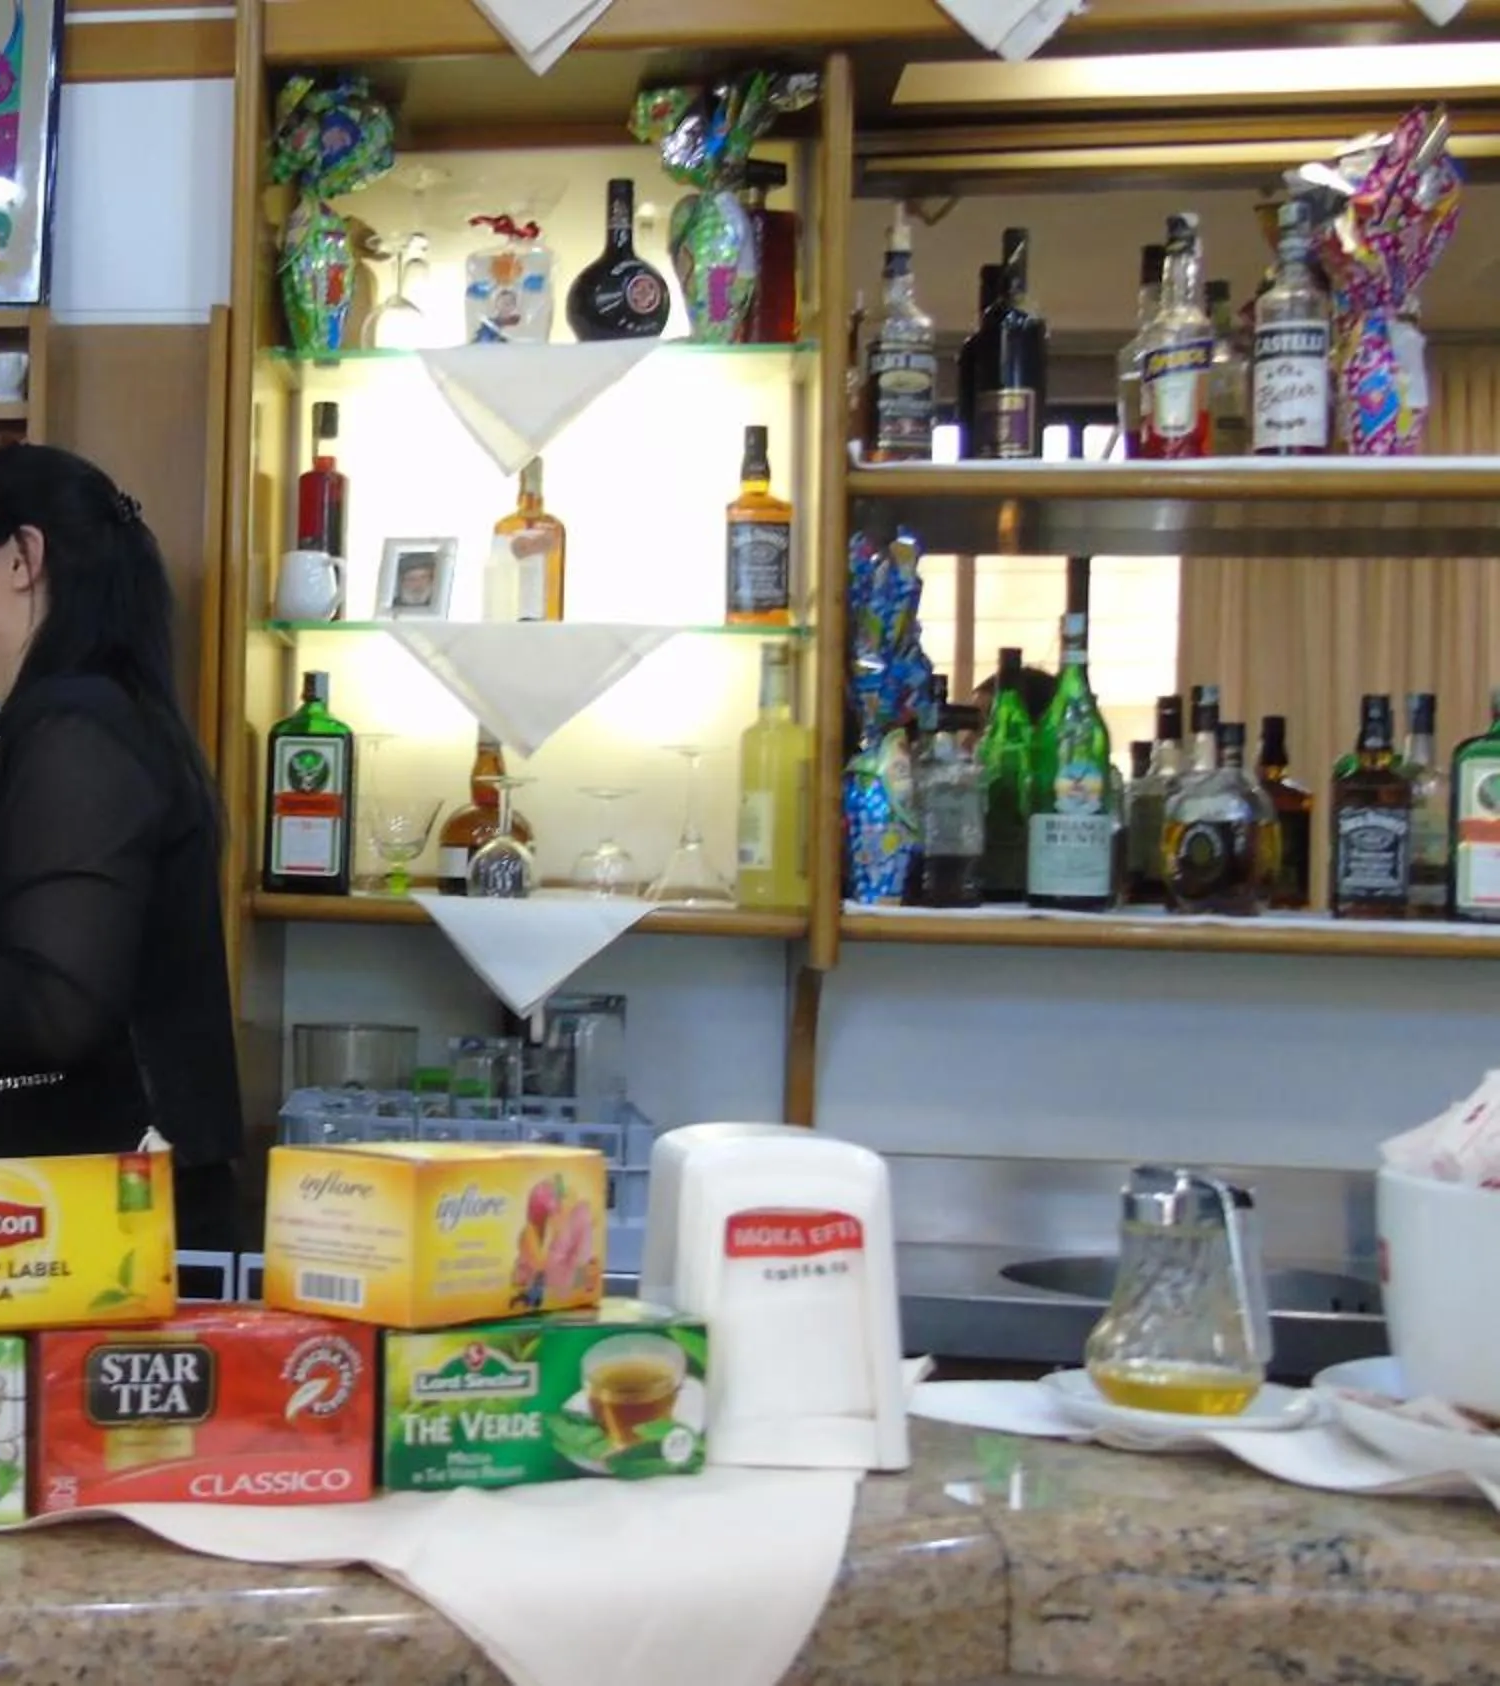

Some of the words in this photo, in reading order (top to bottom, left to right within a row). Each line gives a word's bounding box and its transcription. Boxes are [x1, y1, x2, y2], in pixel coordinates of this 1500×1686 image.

[298, 1169, 376, 1200] infiore
[733, 1225, 806, 1247] MOKA
[7, 1260, 73, 1279] LABEL
[100, 1352, 200, 1384] STAR
[418, 1374, 461, 1390] Lord
[110, 1383, 190, 1415] TEA
[459, 1410, 543, 1443] VERDE
[189, 1468, 352, 1497] CLASSICO
